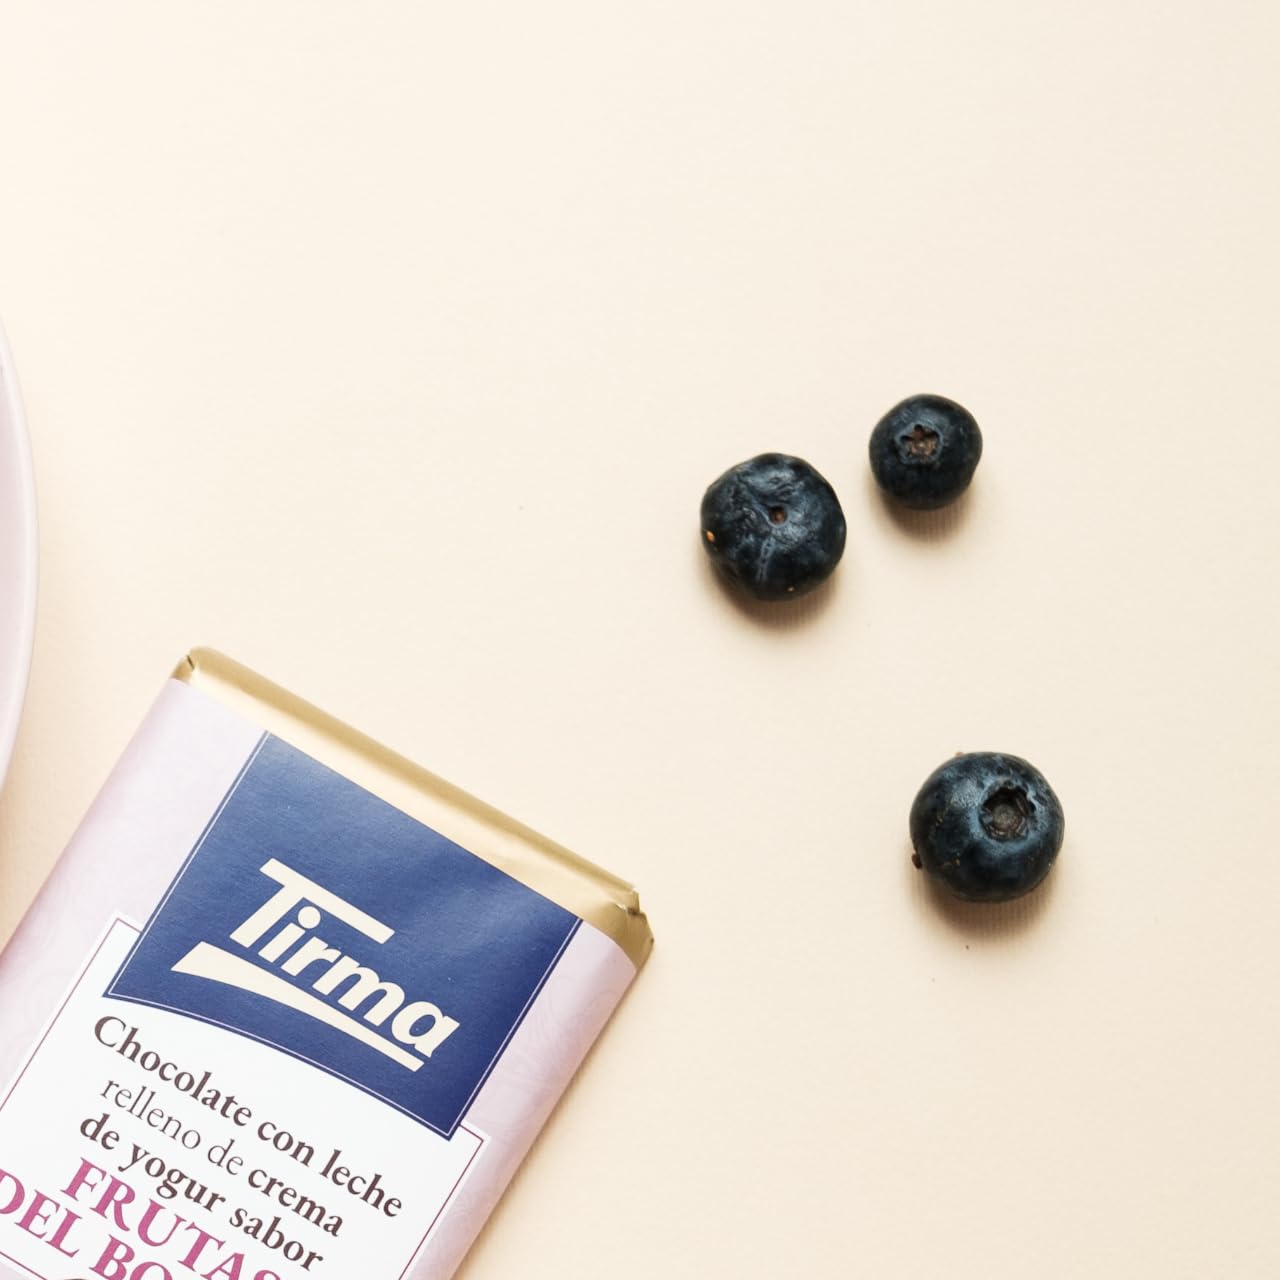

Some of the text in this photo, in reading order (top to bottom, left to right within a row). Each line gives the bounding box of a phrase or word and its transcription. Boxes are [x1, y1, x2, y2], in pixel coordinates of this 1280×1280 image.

[229, 858, 459, 1057] Tirma
[81, 1114, 323, 1271] de yogur sabor
[93, 1015, 403, 1217] Chocolate con leche
[100, 1078, 343, 1237] relleno de crema
